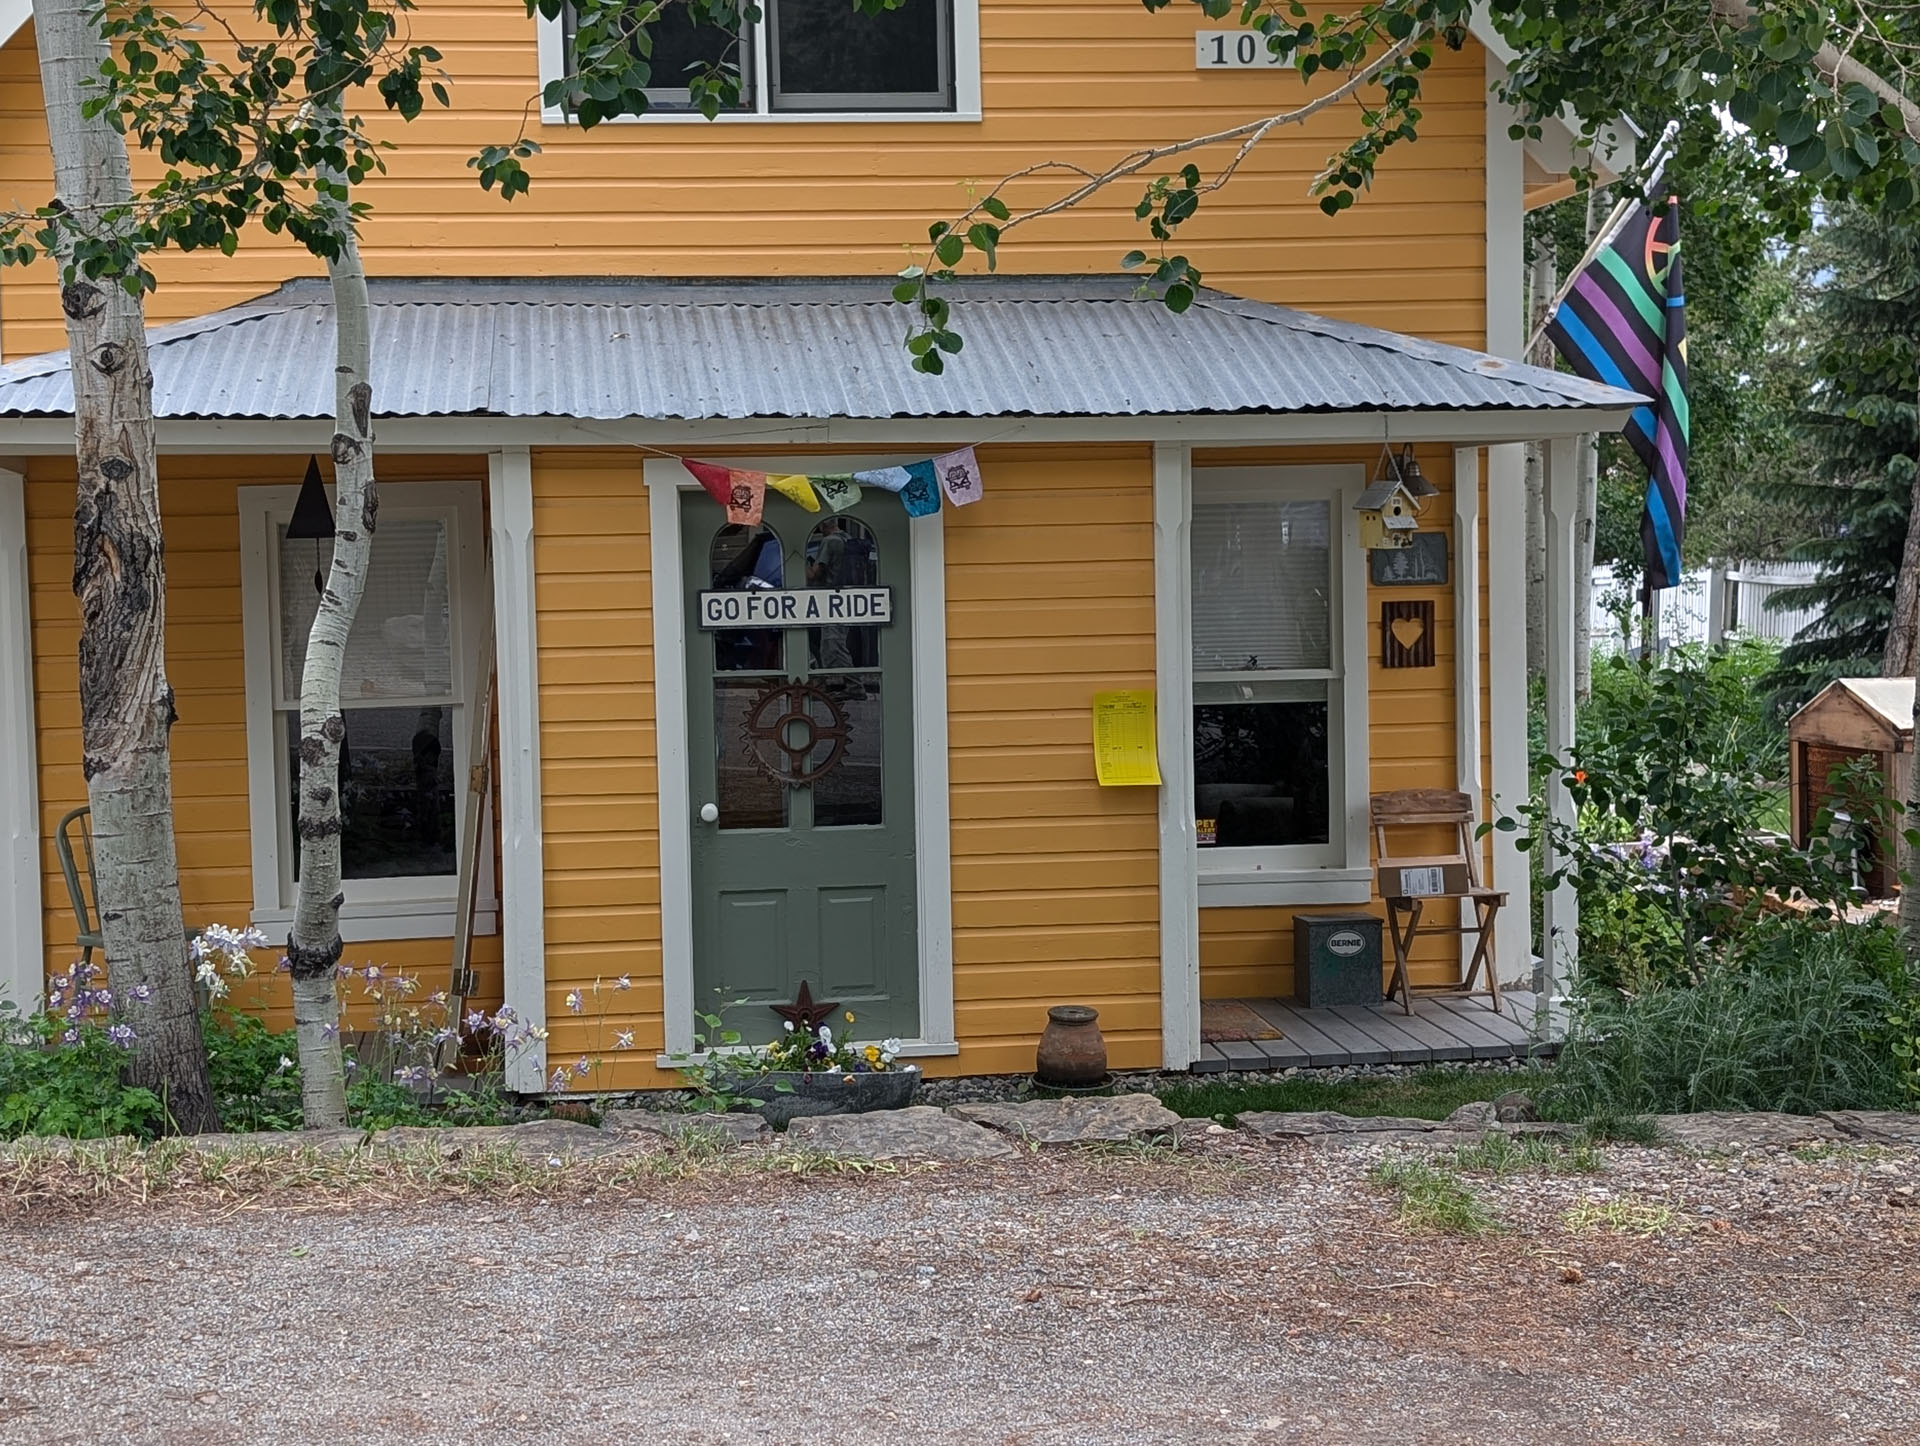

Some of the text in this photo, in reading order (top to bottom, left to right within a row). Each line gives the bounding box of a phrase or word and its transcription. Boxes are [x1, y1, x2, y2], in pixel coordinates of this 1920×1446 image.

[707, 593, 886, 621] GO FOR A RIDE
[1196, 819, 1216, 828] PET
[1331, 939, 1362, 947] BERNIE
